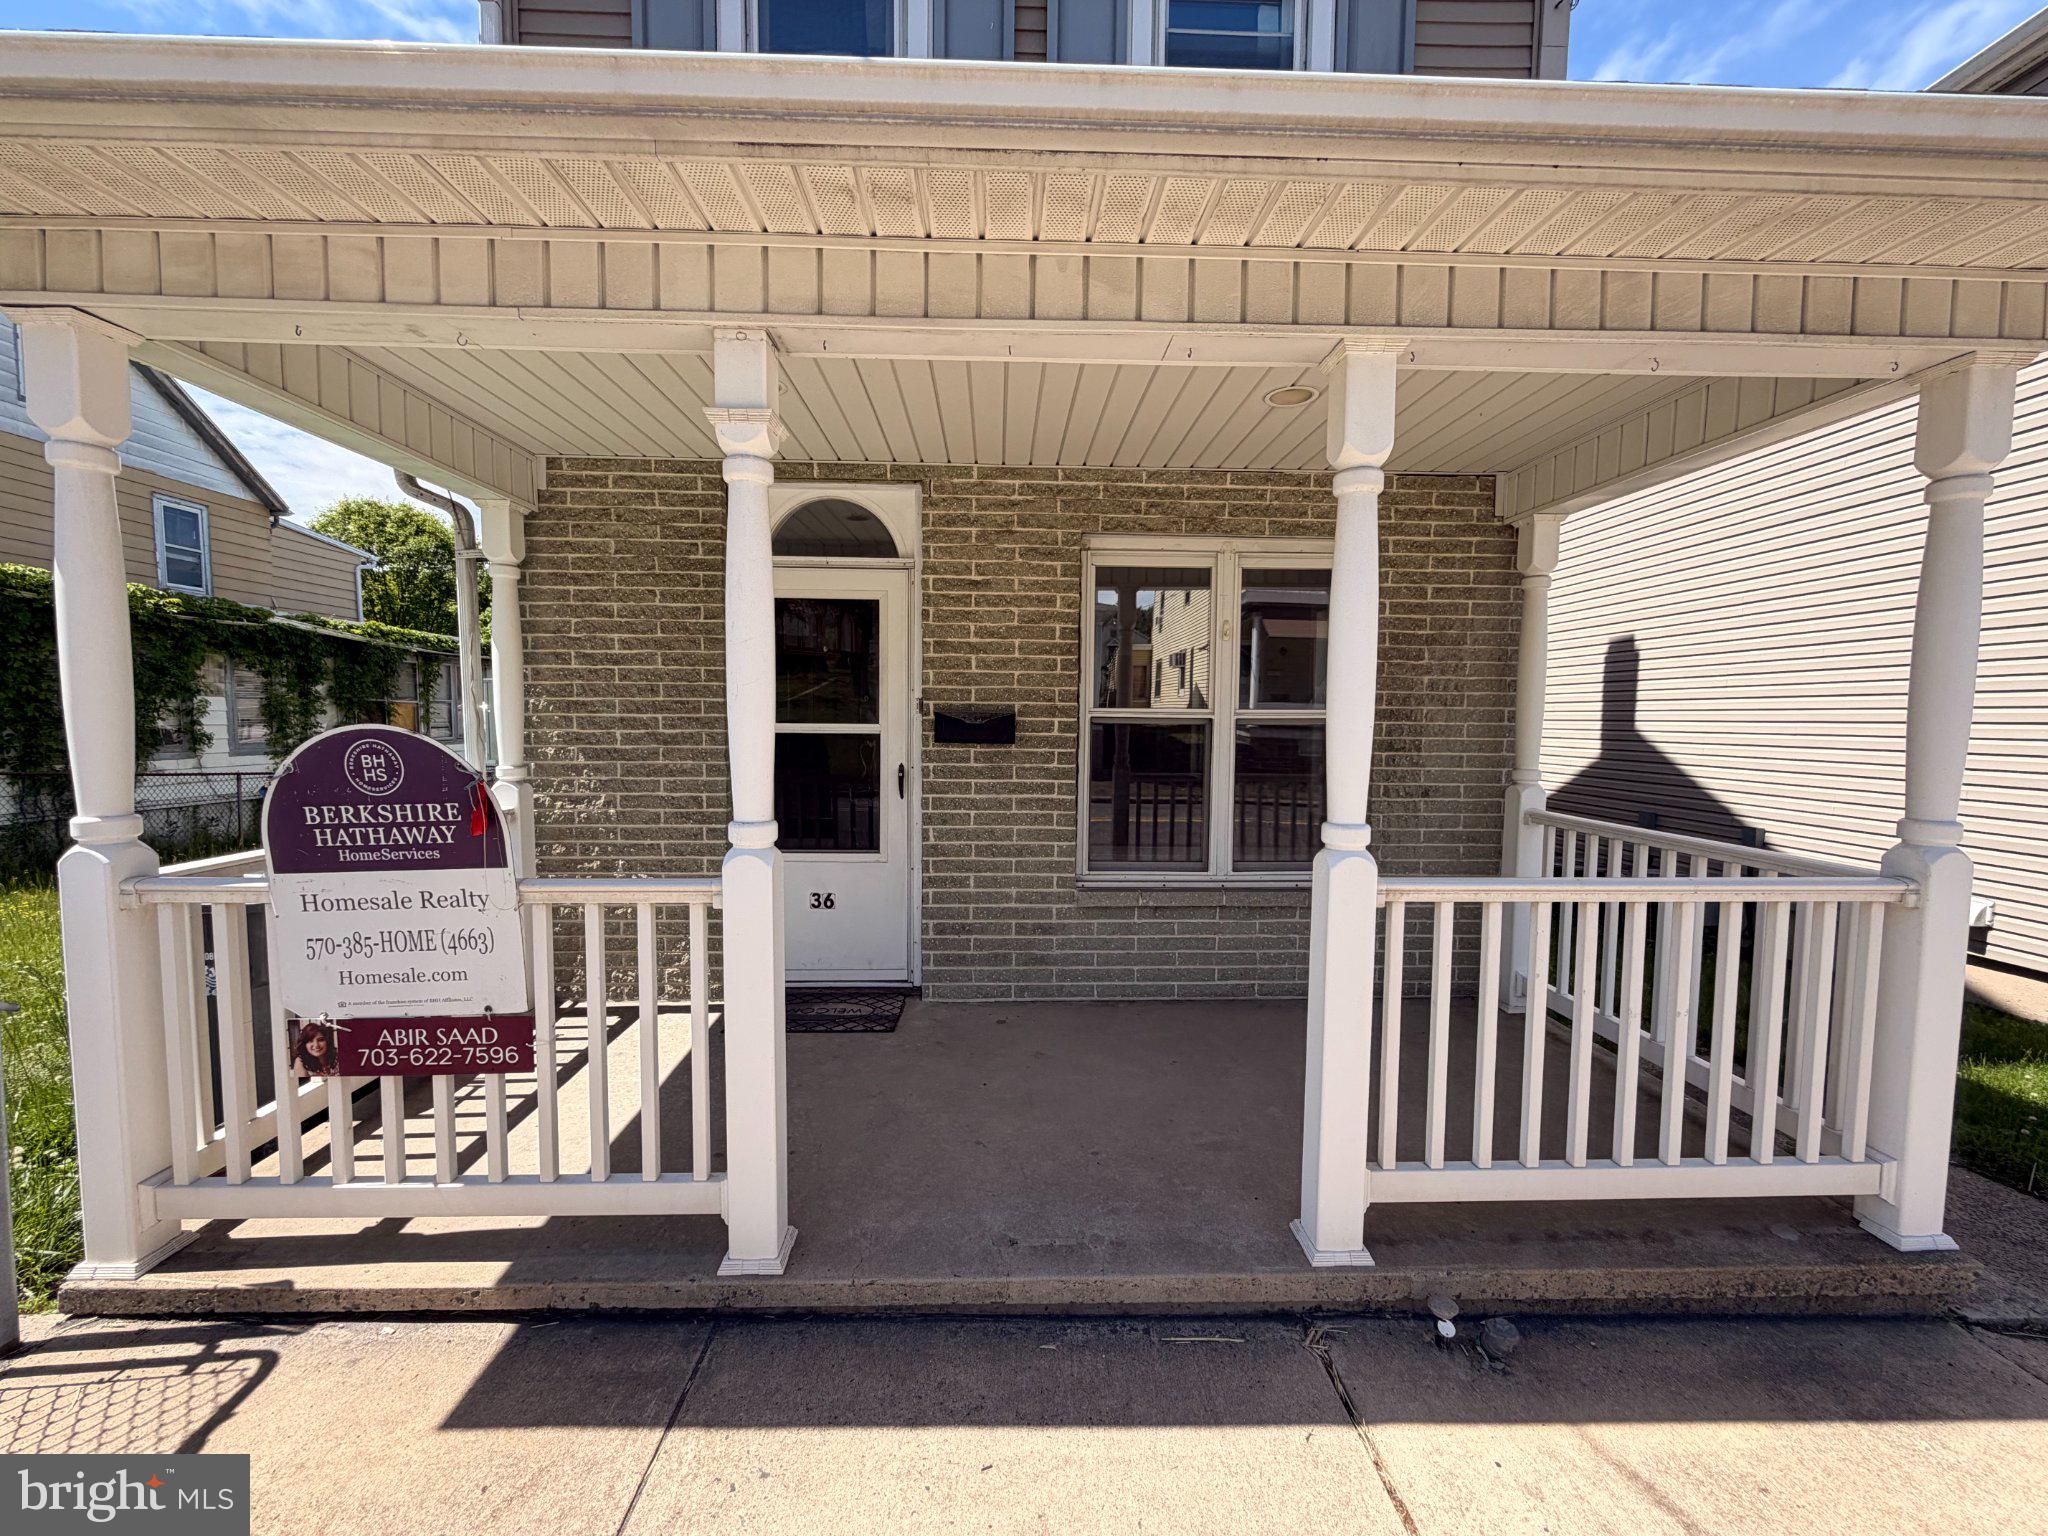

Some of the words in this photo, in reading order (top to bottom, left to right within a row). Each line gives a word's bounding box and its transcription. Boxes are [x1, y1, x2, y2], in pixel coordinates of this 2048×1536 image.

[361, 754, 385, 768] BH
[363, 768, 387, 782] HS
[303, 802, 462, 825] BERKSHIRE
[314, 825, 457, 847] HATHAWAY
[338, 849, 440, 862] HomeServices
[300, 890, 412, 913] Homesale
[418, 888, 490, 914] Realty
[810, 892, 835, 909] 36
[306, 929, 437, 961] 570-385-HOME
[440, 926, 495, 957] (4663)
[338, 967, 468, 986] Homesale.com
[787, 1007, 862, 1015] WELCOM
[377, 1028, 428, 1047] ABIR
[437, 1027, 498, 1046] SAAD
[358, 1046, 519, 1067] 703-622-7596
